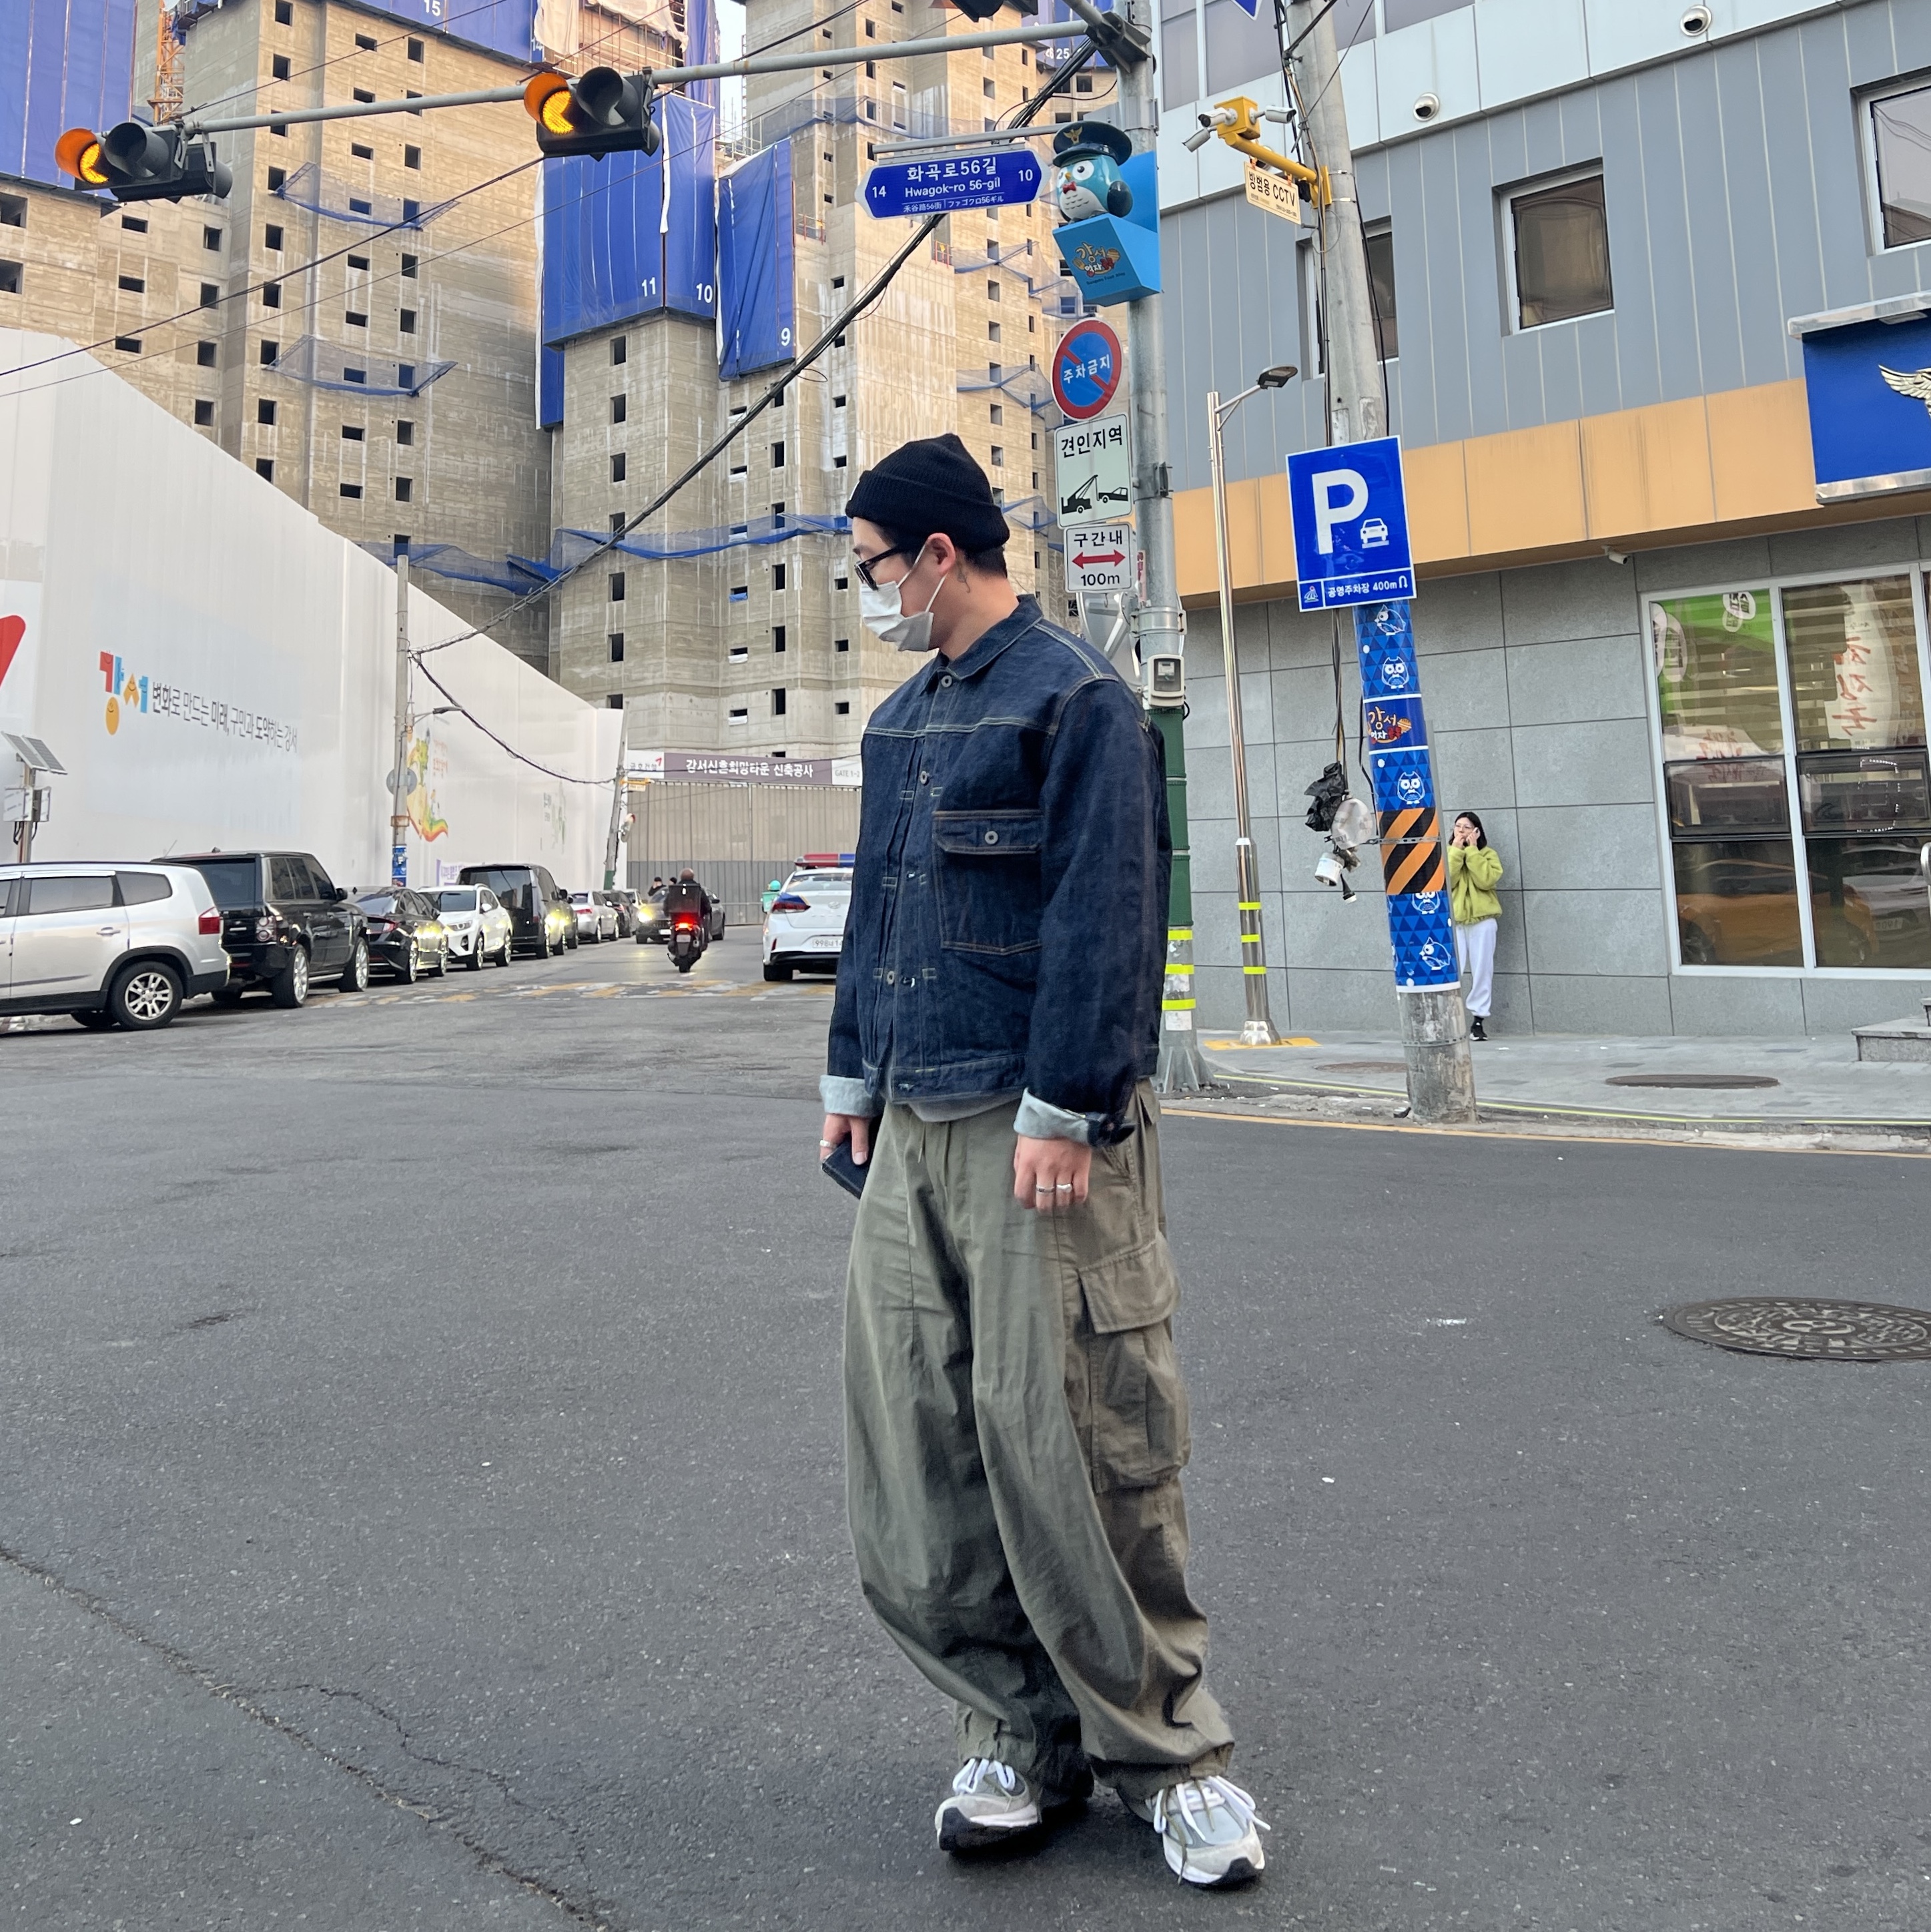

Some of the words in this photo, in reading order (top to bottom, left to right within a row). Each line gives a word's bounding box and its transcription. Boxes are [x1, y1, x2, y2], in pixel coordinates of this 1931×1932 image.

[424, 0, 440, 17] 15
[1056, 48, 1070, 59] 25
[907, 156, 997, 182] 화곡로56길
[1018, 169, 1033, 182] 10
[872, 186, 887, 198] 14
[905, 183, 966, 199] Hwagok-ro
[969, 177, 1001, 192] 56-gil
[1248, 171, 1270, 196] 방범용
[1272, 184, 1295, 207] CCTV
[1076, 242, 1106, 263] 강서
[641, 277, 656, 297] 11
[696, 283, 713, 304] 10
[781, 327, 791, 346] 9
[1063, 354, 1111, 384] 주차금지
[1061, 425, 1123, 458] 견인지역
[1312, 468, 1369, 555] P
[1074, 529, 1123, 548] 구간내
[1080, 574, 1120, 587] 100m
[1328, 582, 1370, 598] 공영주차장
[1373, 581, 1398, 591] 400m
[99, 651, 149, 735] 강서
[153, 681, 180, 717] 변화로
[183, 692, 209, 727] 만드는
[212, 701, 229, 736] 미래,
[230, 707, 254, 740] 구민과
[255, 716, 284, 749] 도약하는
[284, 725, 297, 753] 강서
[1368, 706, 1397, 730] 강서
[773, 763, 813, 777] 신축공사
[835, 769, 849, 777] GATE
